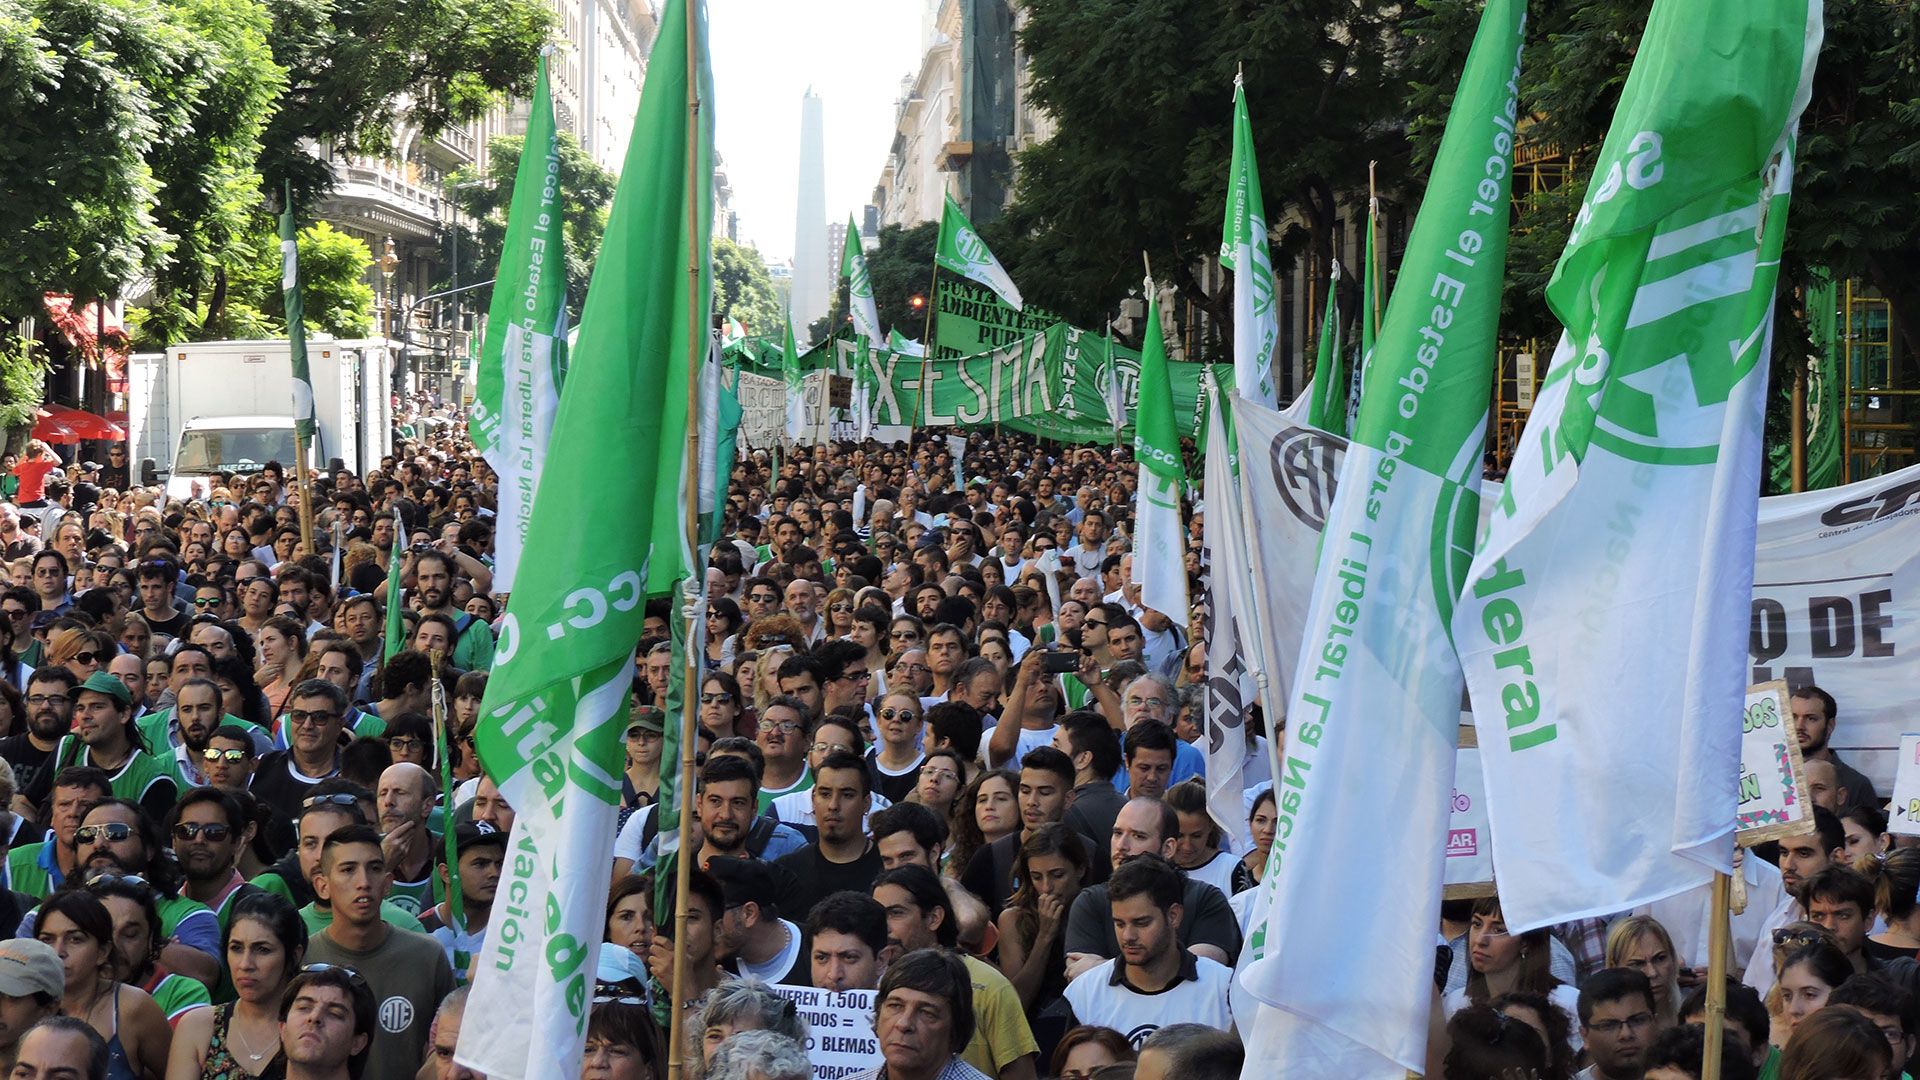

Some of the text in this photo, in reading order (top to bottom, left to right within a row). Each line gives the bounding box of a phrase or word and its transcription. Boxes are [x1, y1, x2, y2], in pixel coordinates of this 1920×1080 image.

[938, 293, 1028, 330] AMBIENTE
[1055, 325, 1085, 409] JUNTA
[1809, 589, 1895, 659] DE
[822, 1036, 876, 1055] BLEMAS
